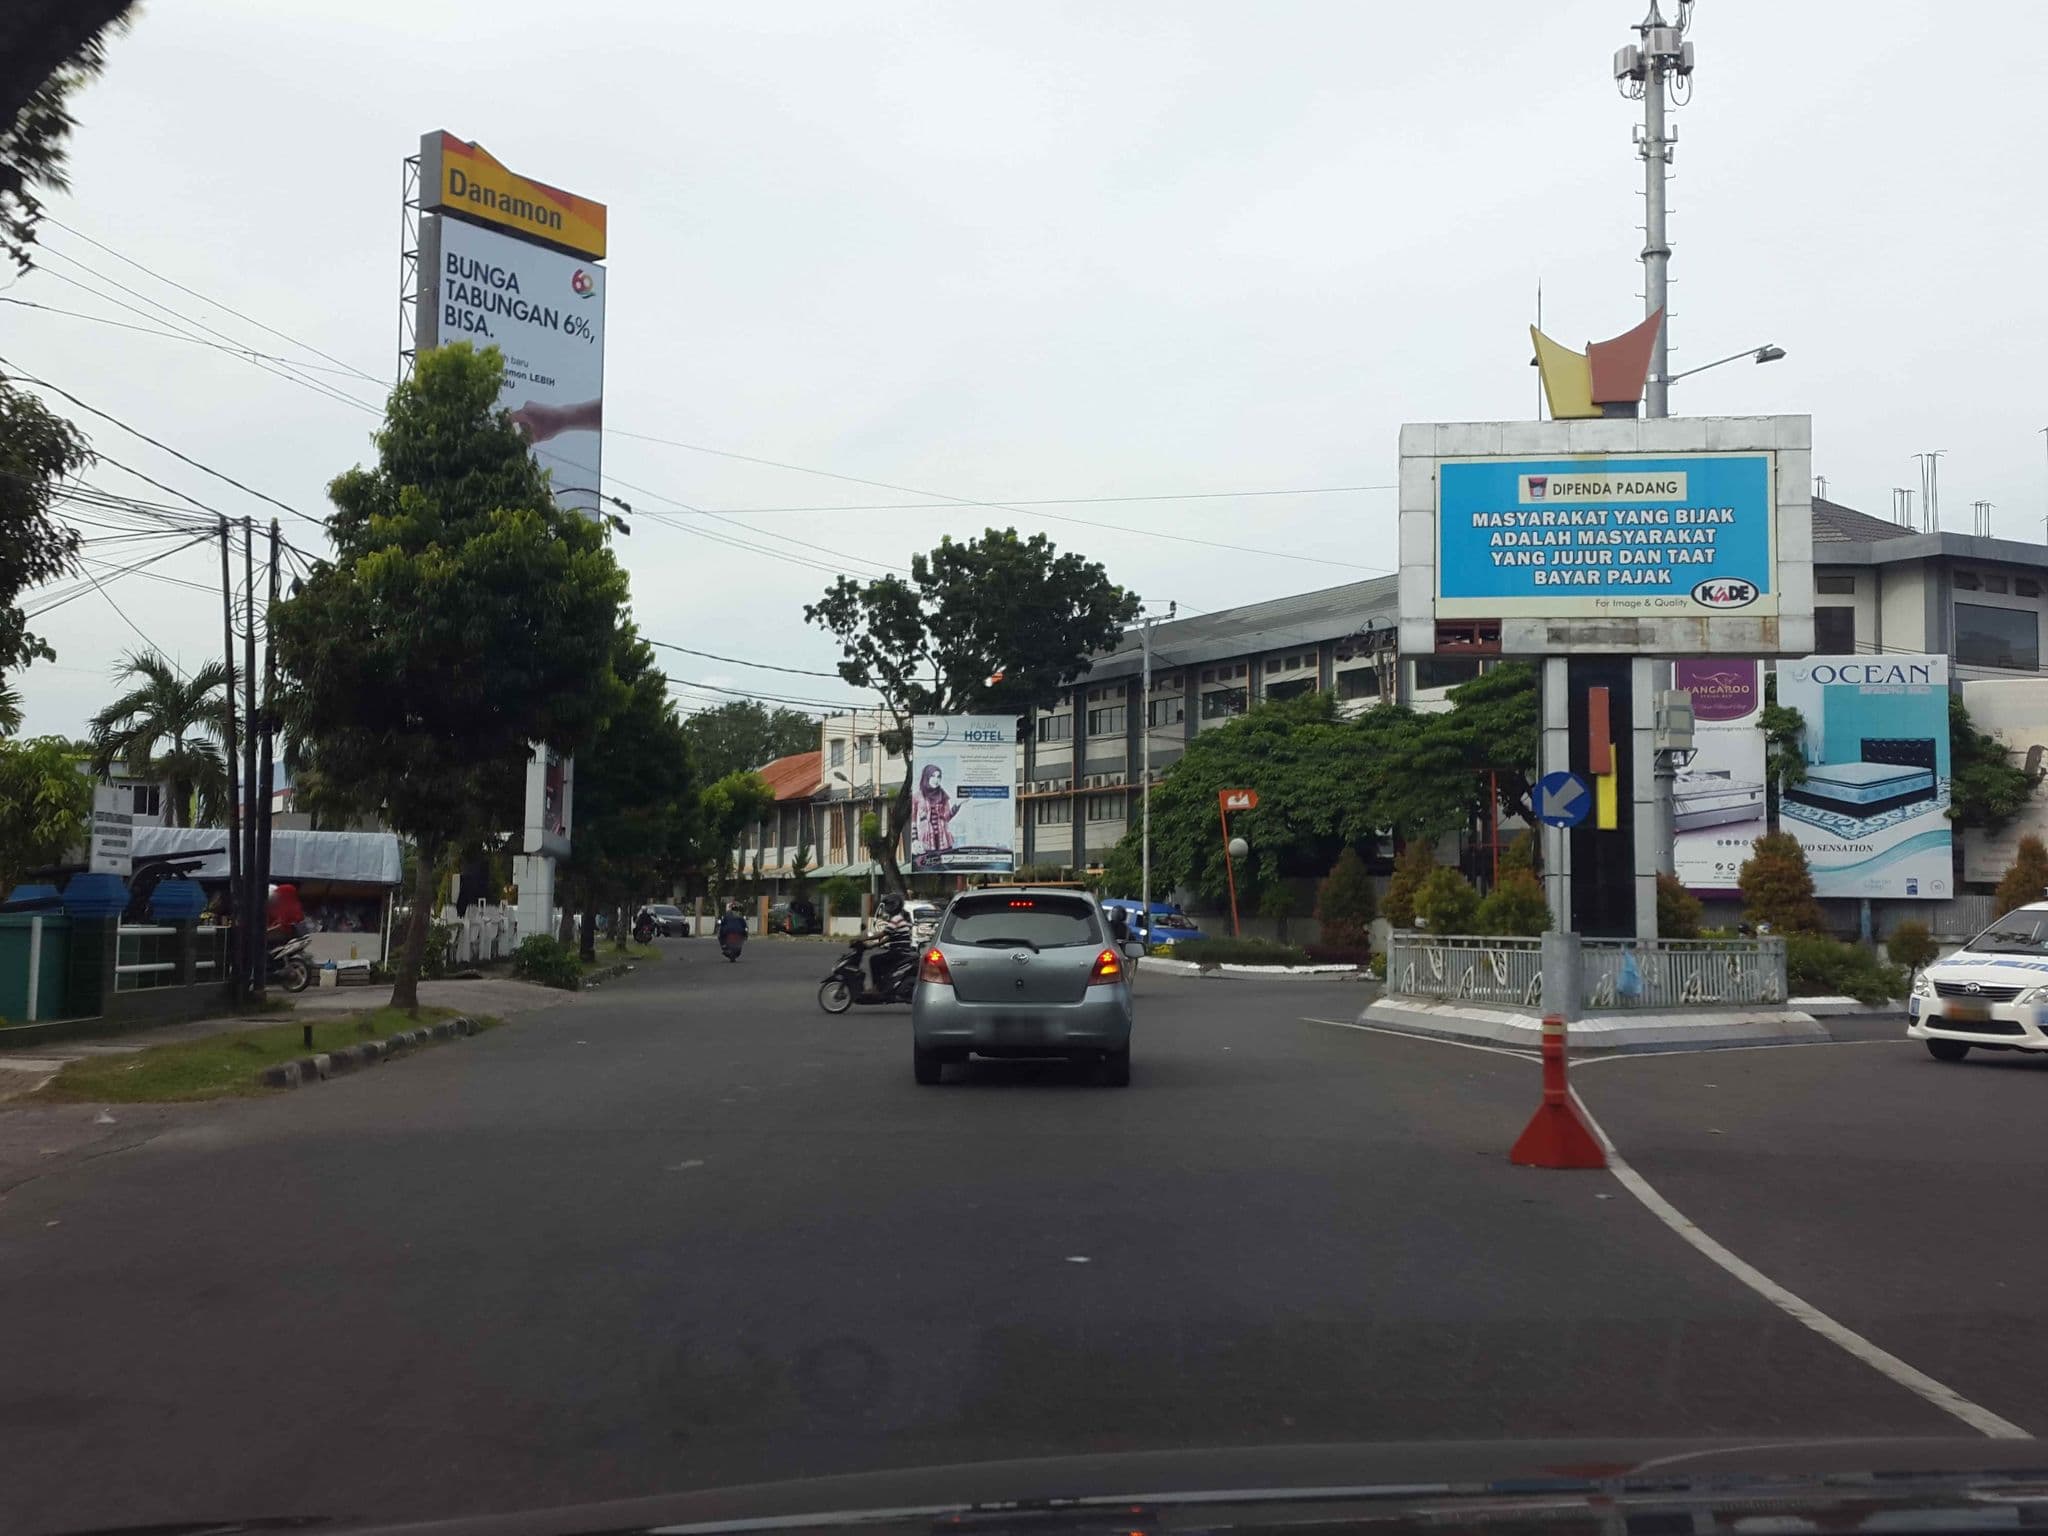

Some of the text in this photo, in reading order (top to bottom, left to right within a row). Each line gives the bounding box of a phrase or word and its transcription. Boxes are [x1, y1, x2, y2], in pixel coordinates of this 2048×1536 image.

[450, 167, 562, 230] Danamon
[446, 252, 520, 295] BUNGA
[445, 278, 595, 344] TABUNGAN 6%,
[444, 304, 494, 338] BISA.
[529, 373, 555, 387] LEBIH
[1552, 481, 1678, 496] DIPENDA PADANG
[1472, 508, 1735, 527] MASYARAKAT YANG BIJAK
[1489, 529, 1717, 547] ADALAH MASYARAKAT
[1491, 548, 1716, 566] YANG JUJUR DAN TAAT
[1534, 569, 1672, 586] BAYAR PAJAK
[1595, 598, 1688, 609] For Image & Quality
[1701, 585, 1750, 604] KADE
[1811, 664, 1930, 684] OCEAN
[1683, 685, 1750, 694] KANGAROO
[964, 730, 1004, 741] HOTEL
[1817, 843, 1874, 852] SENSATION
